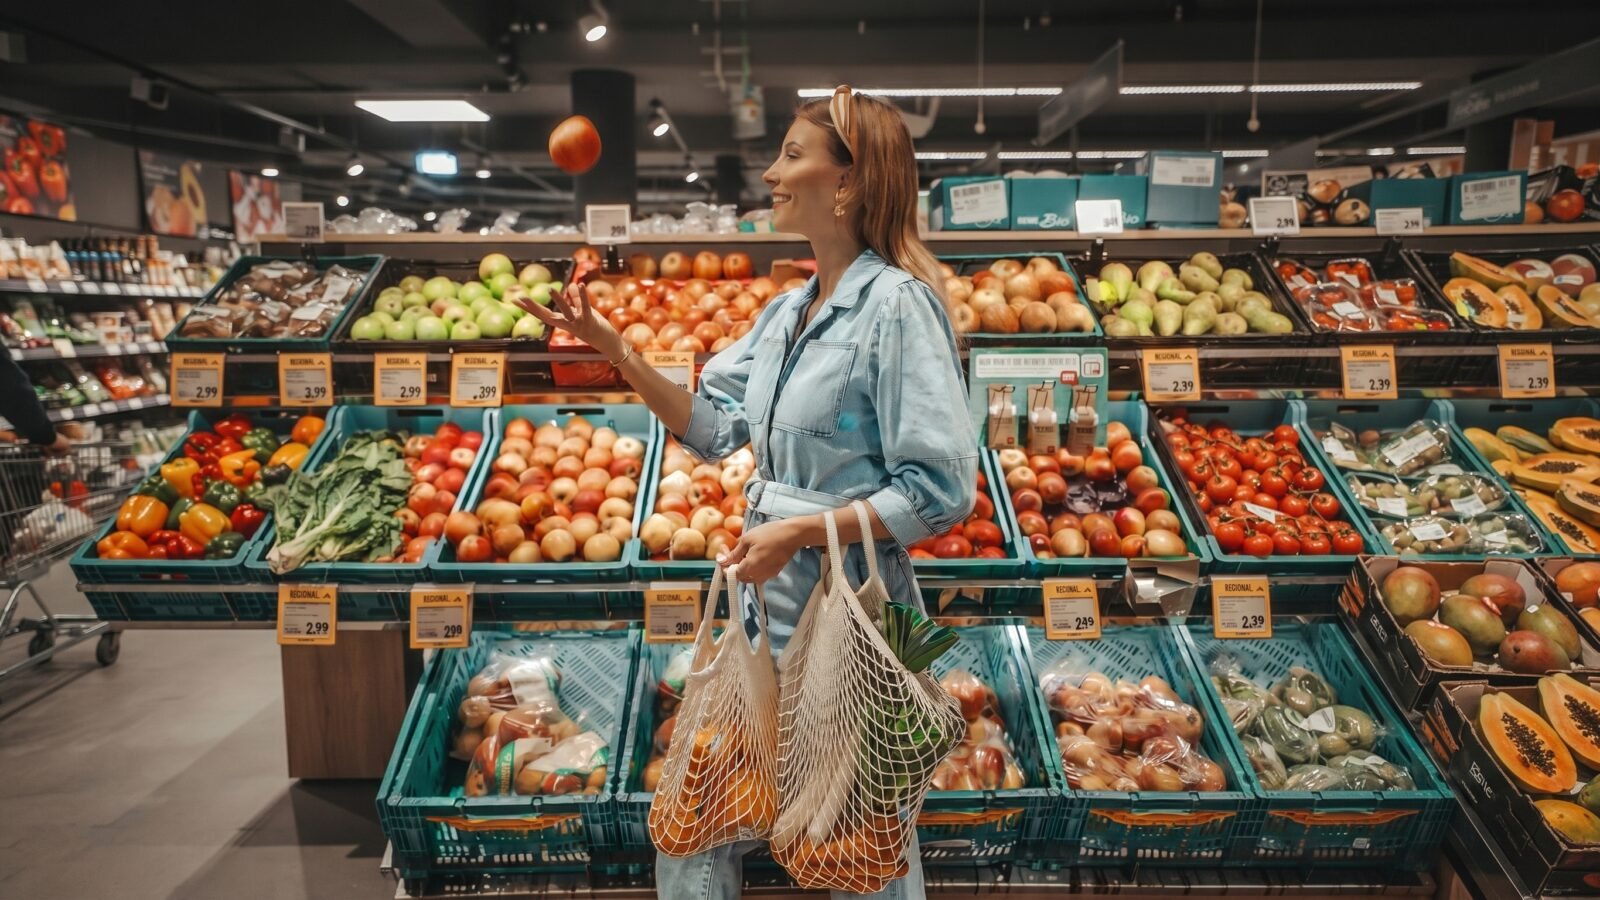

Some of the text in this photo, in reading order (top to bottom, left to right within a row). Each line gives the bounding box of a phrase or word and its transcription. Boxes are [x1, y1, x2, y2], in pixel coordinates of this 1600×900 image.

[1039, 212, 1070, 228] Bio
[1154, 352, 1182, 360] REGIONAL
[1352, 349, 1378, 358] REGIONAL
[1172, 380, 1194, 392] 2.39
[1528, 377, 1549, 389] 2.39
[196, 386, 218, 398] 2.99
[304, 386, 327, 399] 3.99
[400, 386, 421, 398] 2.99
[1056, 585, 1081, 593] REGIONAL
[1225, 583, 1254, 592] REGIONAL
[290, 590, 320, 599] REGIONAL
[306, 621, 329, 635] 2.99
